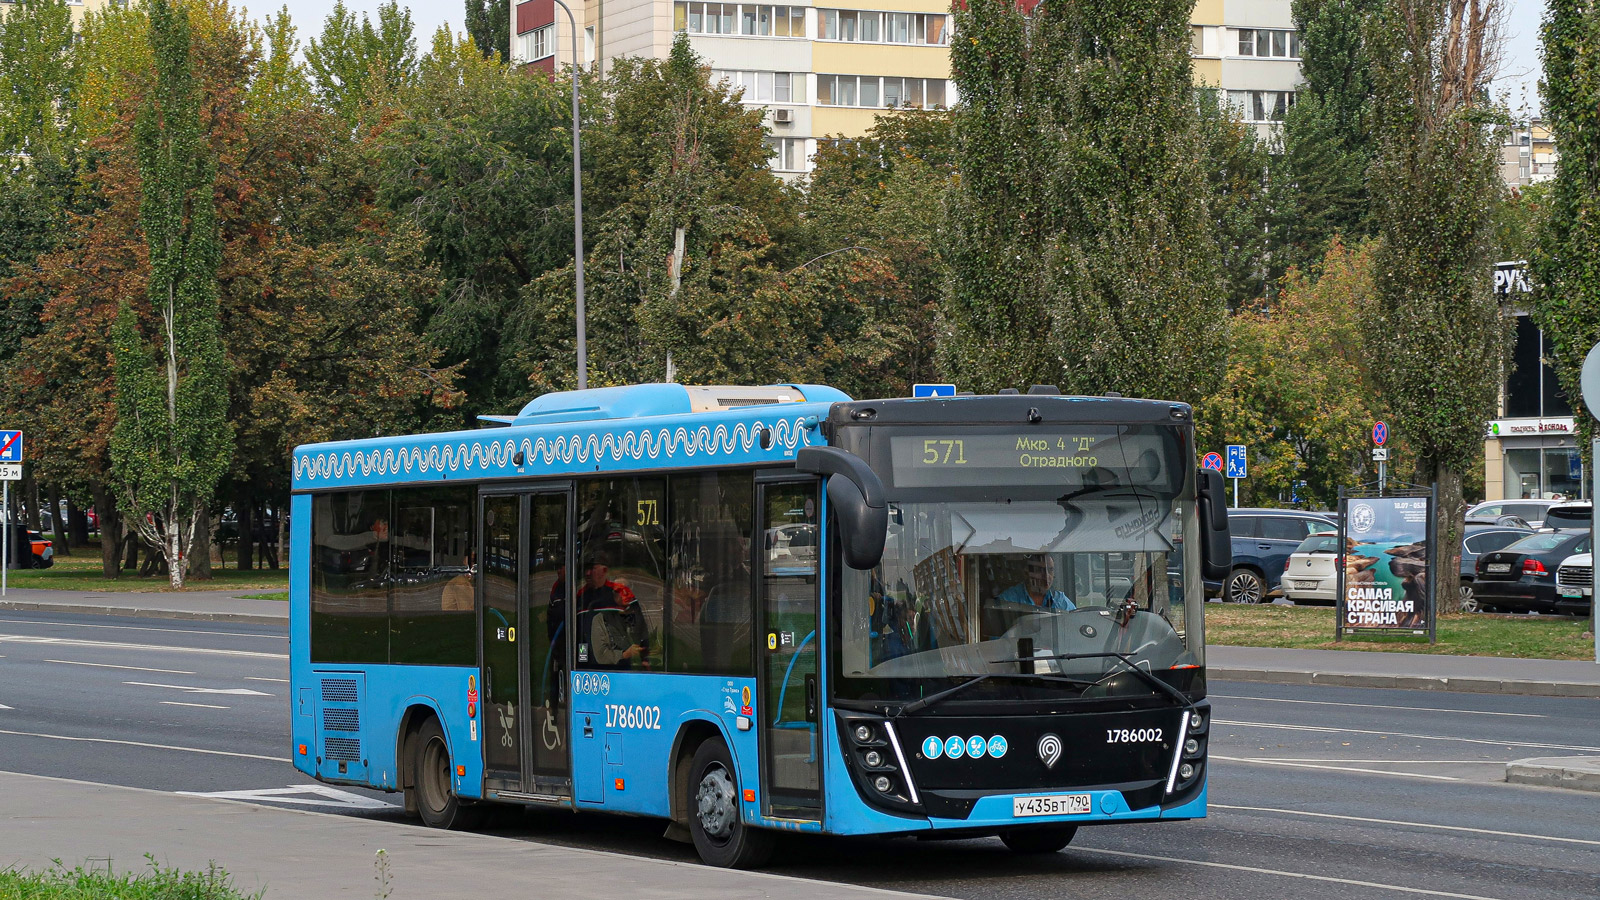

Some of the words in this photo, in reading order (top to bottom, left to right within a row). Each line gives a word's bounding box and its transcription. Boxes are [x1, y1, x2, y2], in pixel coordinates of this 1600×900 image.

[1015, 437, 1050, 451] Мкр.
[1056, 437, 1066, 451] 4
[1072, 436, 1096, 451] "Д"
[922, 439, 968, 465] 571
[1018, 453, 1099, 468] Отрадного
[636, 499, 660, 526] 571
[1347, 587, 1393, 600] САМАЯ
[1347, 600, 1415, 613] КРАСИВАЯ
[1347, 612, 1398, 625] СТРАНА
[604, 703, 662, 730] 1786002
[1106, 728, 1163, 744] 1786002
